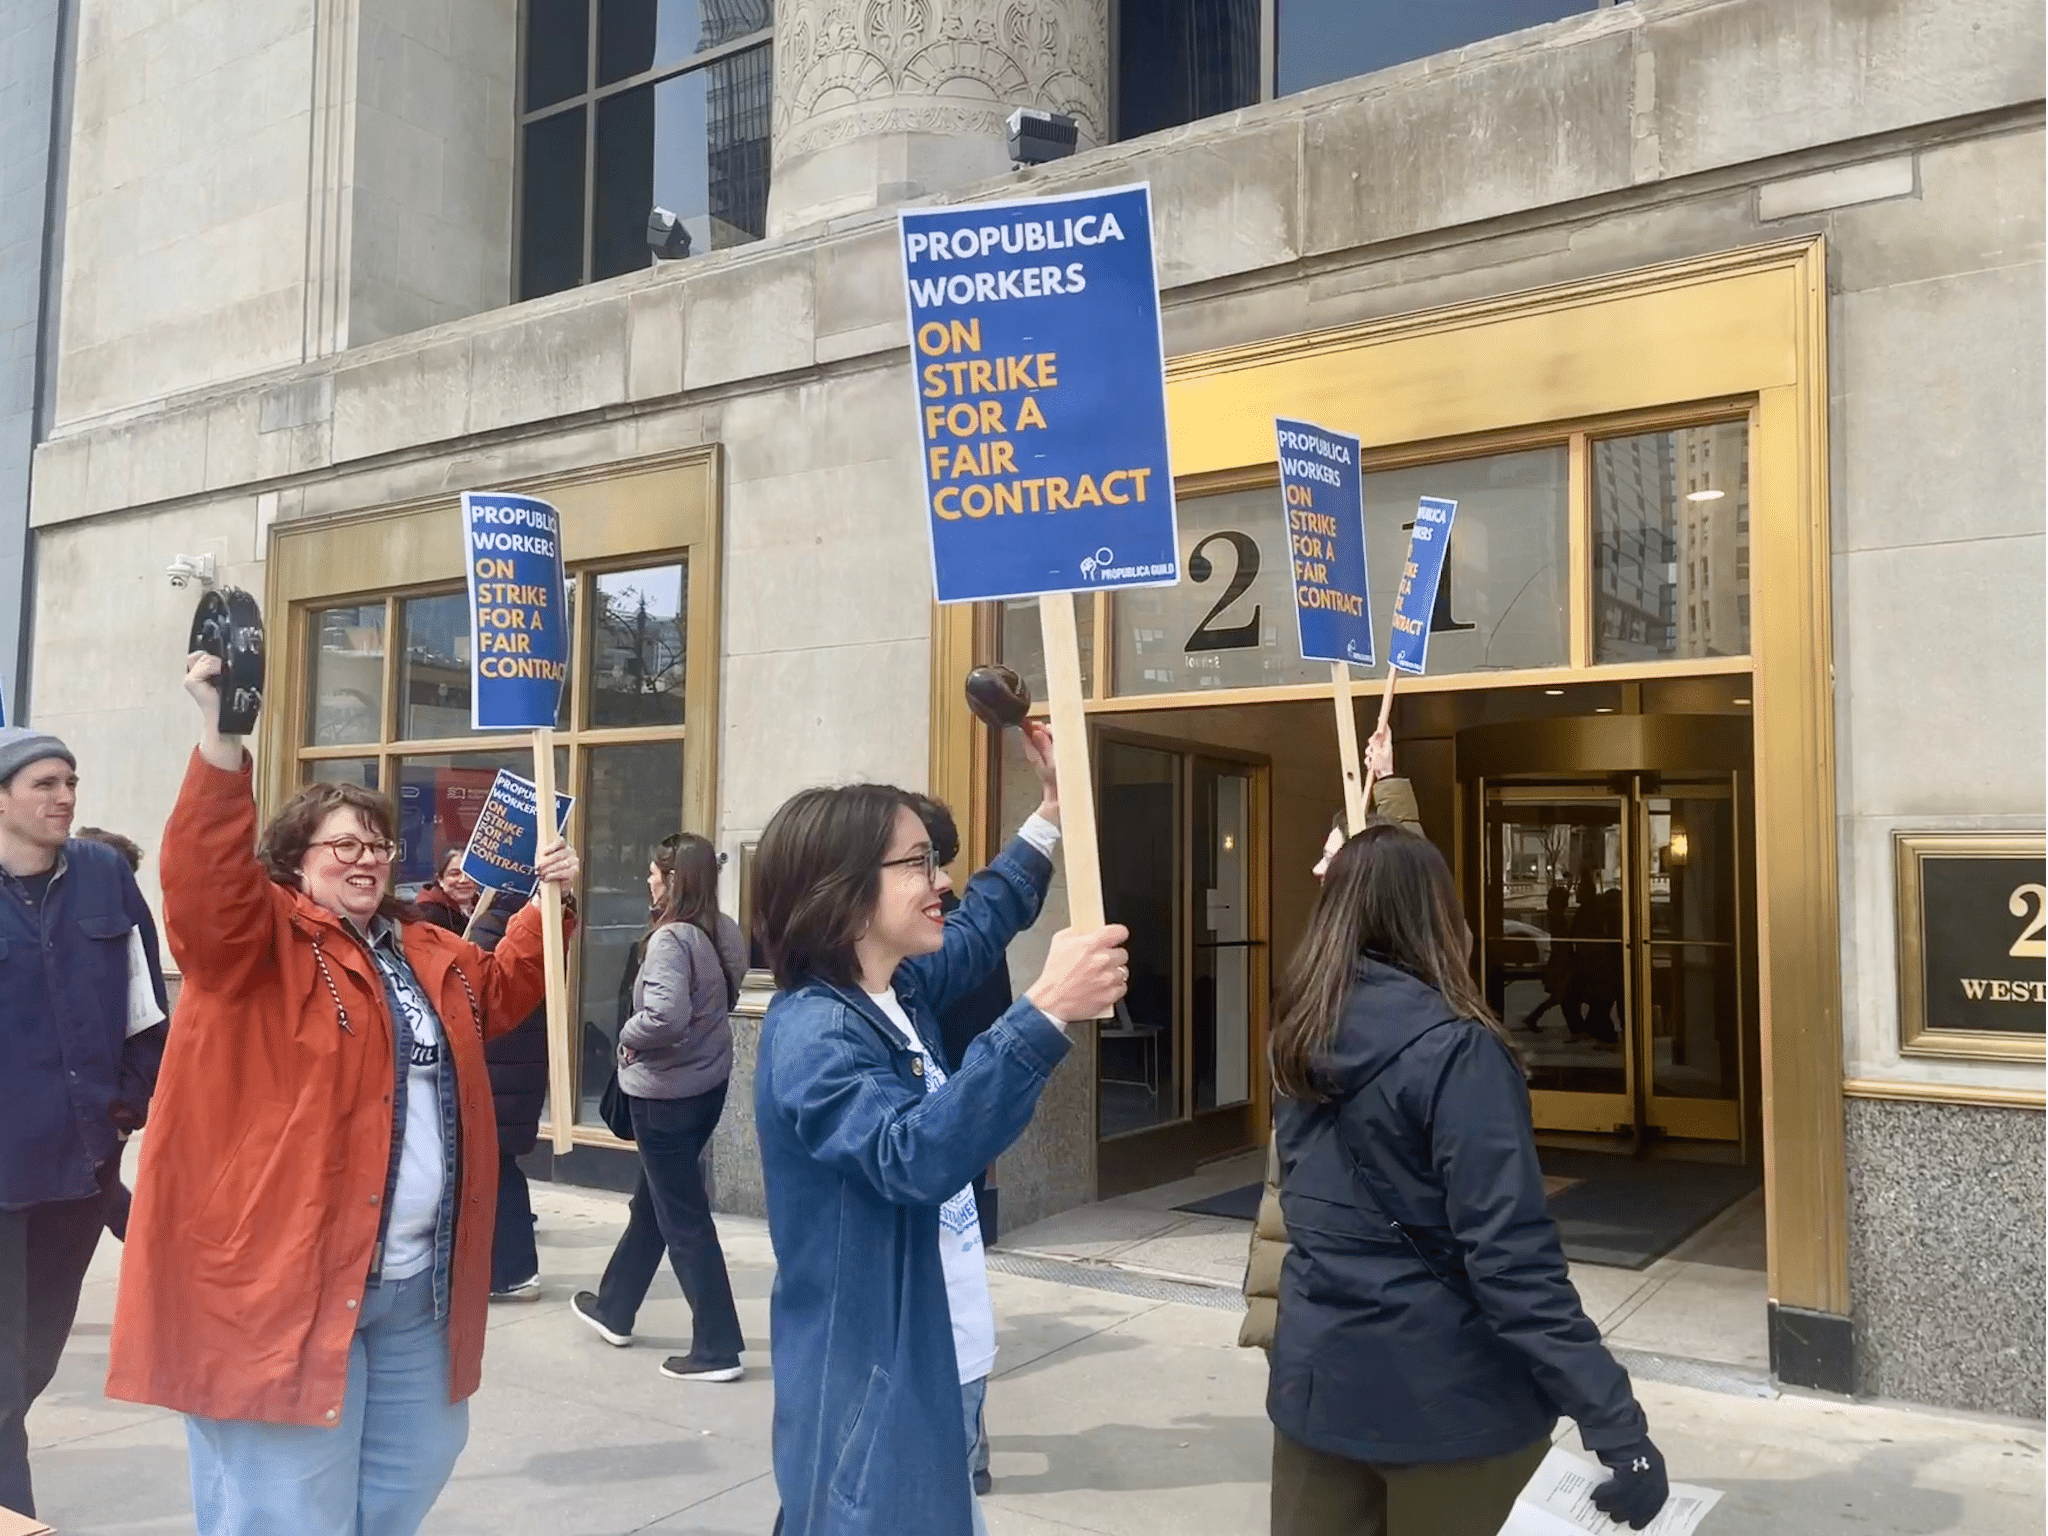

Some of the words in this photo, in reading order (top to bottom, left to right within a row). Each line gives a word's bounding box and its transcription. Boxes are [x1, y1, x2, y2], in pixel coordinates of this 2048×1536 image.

[907, 213, 1125, 262] PROPUBLICA
[909, 263, 1086, 308] WORKERS
[918, 318, 981, 356] ON
[923, 353, 1058, 398] STRIKE
[925, 401, 1007, 439] FOR
[1015, 397, 1047, 431] A
[929, 440, 1019, 480] FAIR
[1278, 430, 1351, 465] PROPUBLICA
[1281, 457, 1341, 487] WORKERS
[933, 468, 1151, 520] CONTRACT
[1286, 485, 1313, 507] ON
[1289, 510, 1337, 538] STRIKE
[473, 531, 555, 558] WORKERS
[1292, 534, 1323, 560] FOR
[1326, 543, 1335, 562] A
[475, 558, 515, 579] ON
[1100, 565, 1151, 580] PROPUBLICA
[1150, 563, 1175, 576] GUILD
[1294, 561, 1328, 584] FAIR
[478, 583, 547, 607] STRIKE
[1184, 530, 1262, 652] 2
[1297, 586, 1364, 617] CONTRACT
[478, 608, 526, 629] FOR
[530, 611, 543, 631] A
[479, 632, 531, 653] FAIR
[479, 657, 567, 682] CONTRAC
[488, 800, 508, 817] ON
[493, 788, 538, 815] WORKER
[478, 821, 502, 841] FOR
[502, 835, 513, 846] A
[483, 811, 525, 838] STRIKE
[474, 831, 500, 853] FAIR
[2008, 883, 2047, 958] 2
[1959, 978, 2047, 1003] WEST
